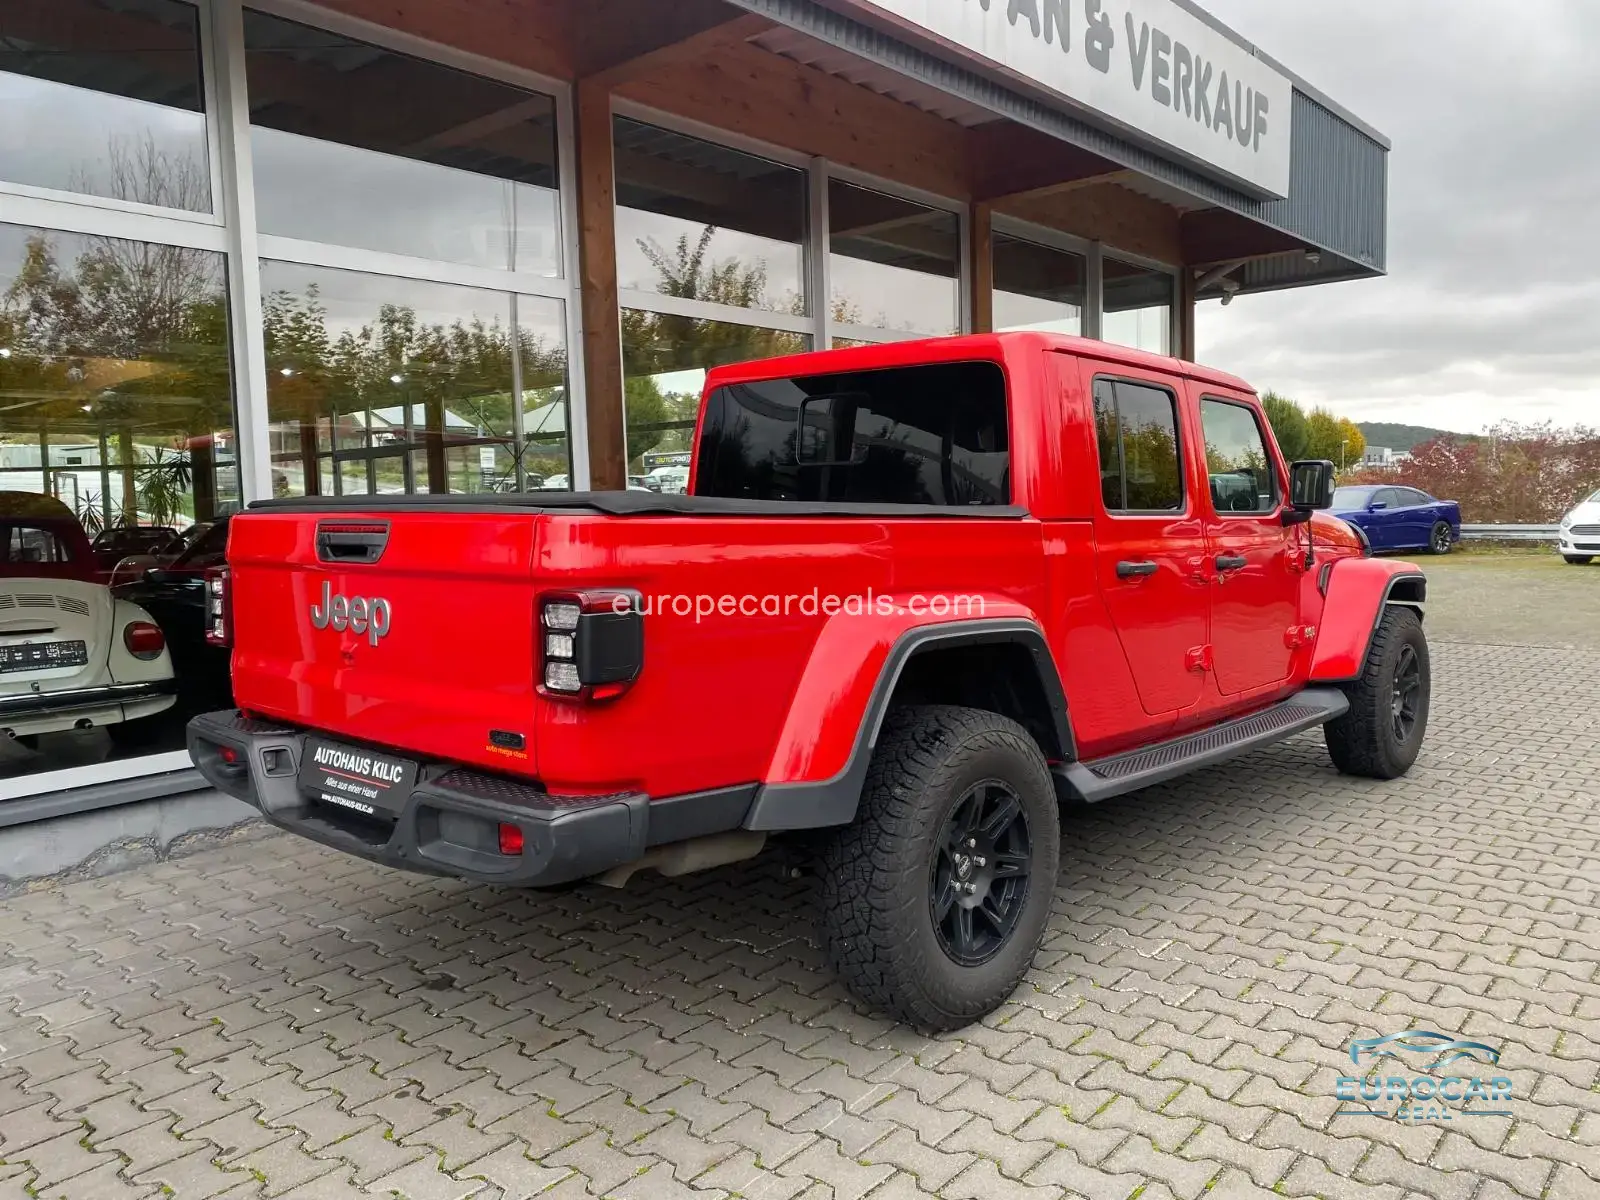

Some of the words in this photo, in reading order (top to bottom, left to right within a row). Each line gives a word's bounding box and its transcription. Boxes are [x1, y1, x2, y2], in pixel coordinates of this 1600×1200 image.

[1084, 0, 1115, 74] &
[1125, 12, 1269, 153] VERKAUF
[310, 580, 390, 647] Jeep
[314, 746, 371, 775] AUTOHAUS
[372, 760, 403, 783] KILIC
[324, 776, 338, 788] Alles
[337, 780, 348, 791] aus
[347, 783, 362, 795] einer
[361, 786, 378, 799] Hand
